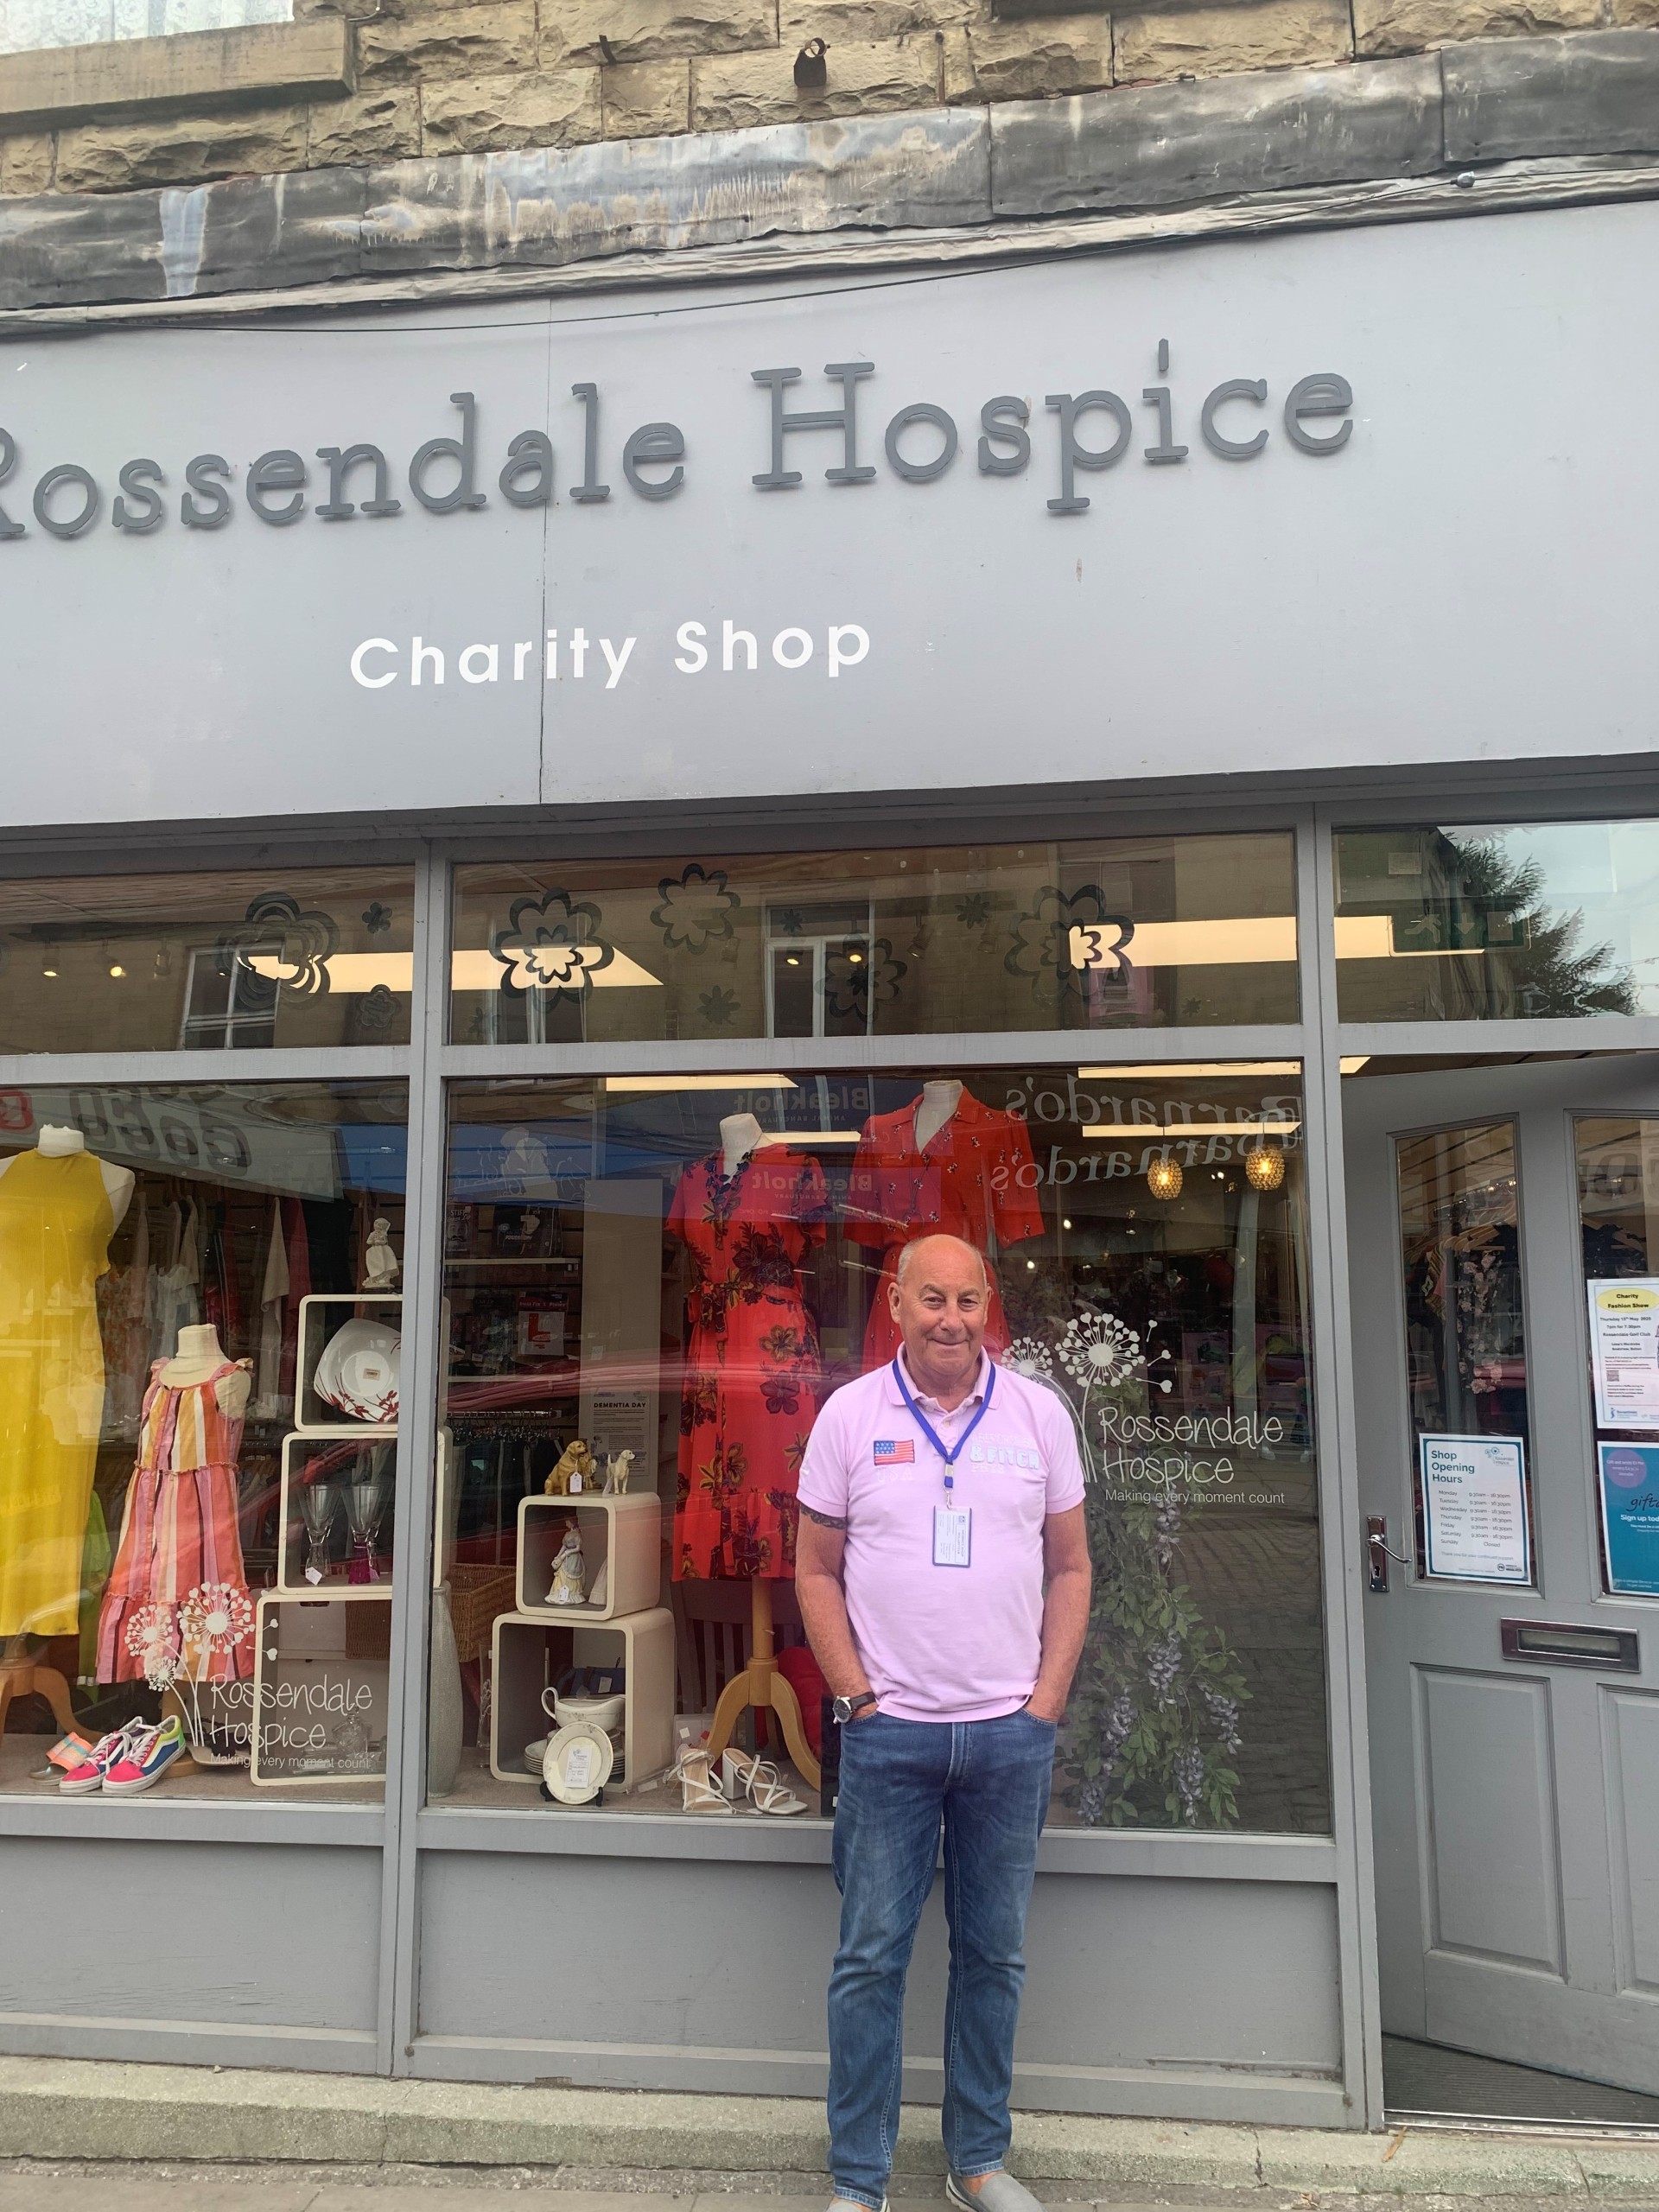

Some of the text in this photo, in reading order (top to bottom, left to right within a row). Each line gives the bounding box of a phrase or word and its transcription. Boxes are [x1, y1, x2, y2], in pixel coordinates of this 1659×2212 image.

[750, 338, 1354, 510] Hospice
[350, 620, 870, 689] Charity Shop
[1097, 1406, 1283, 1449] Rossendale
[1102, 1446, 1234, 1491] Hospice
[1431, 1450, 1457, 1461] Shop
[1431, 1462, 1475, 1474] Opening
[1105, 1489, 1285, 1504] Making every moment count
[1432, 1474, 1463, 1484] Hours
[210, 1673, 372, 1716] Rossendale
[209, 1713, 327, 1755] Hospice
[210, 1752, 371, 1769] Making every moment count
